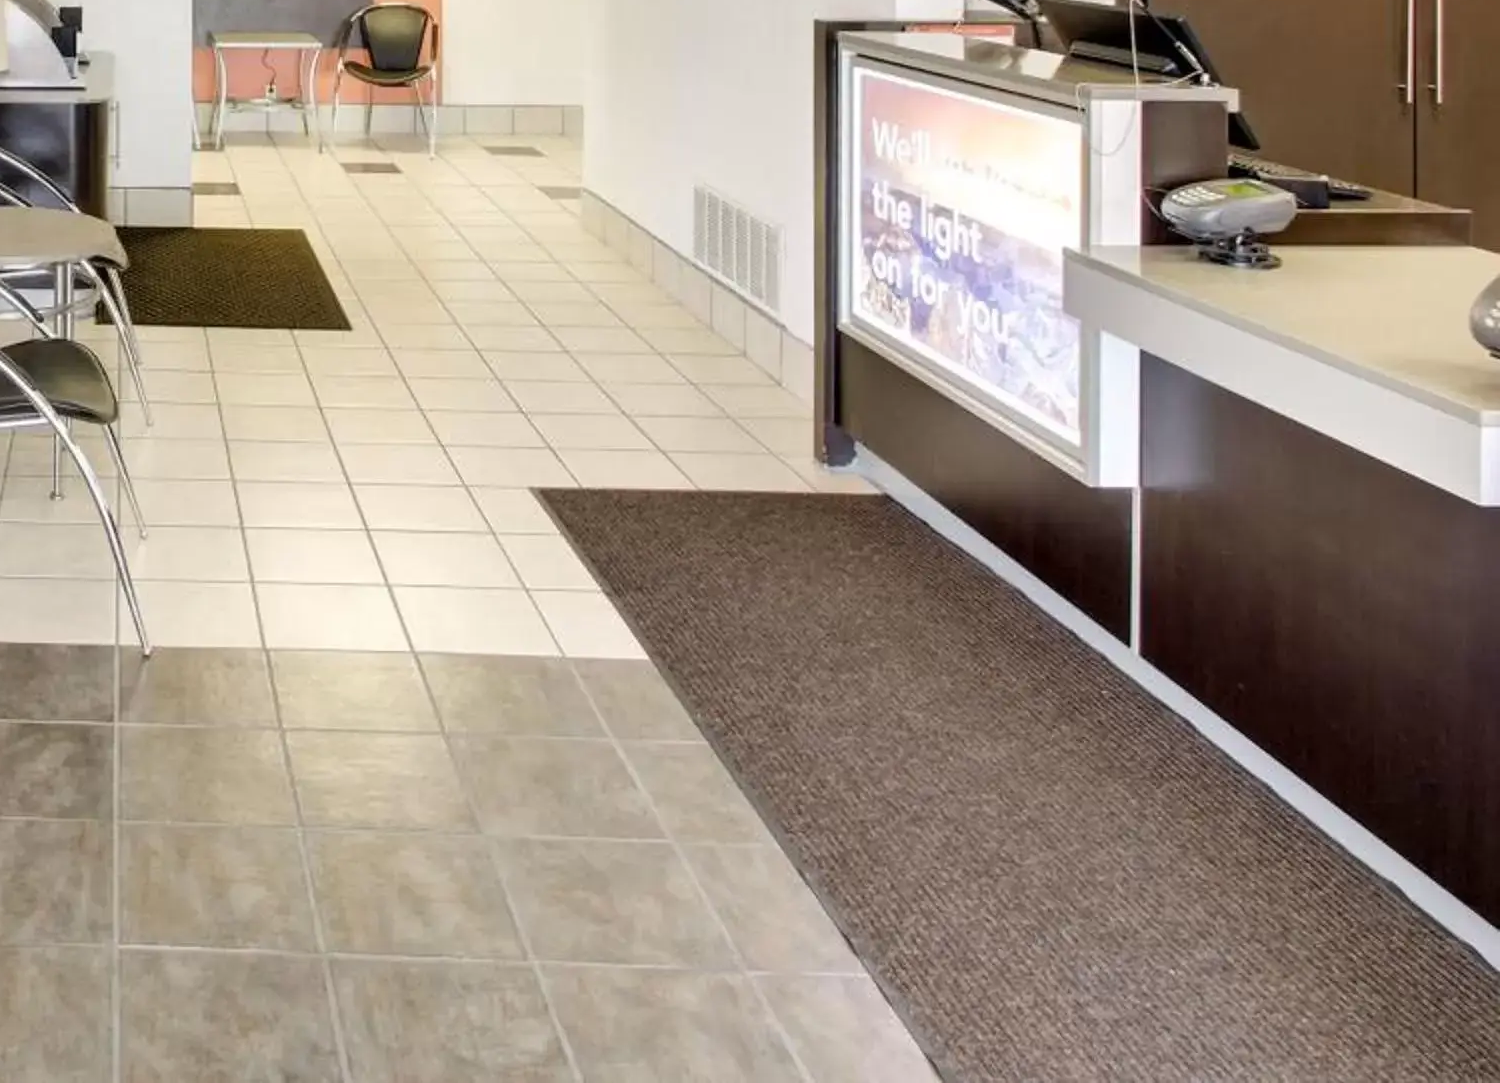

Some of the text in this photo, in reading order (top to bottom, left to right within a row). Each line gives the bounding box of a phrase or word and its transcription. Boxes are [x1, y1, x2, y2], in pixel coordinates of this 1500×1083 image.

[872, 116, 930, 164] We'll
[872, 180, 983, 264] the light
[872, 250, 902, 289] on
[911, 254, 949, 310] for
